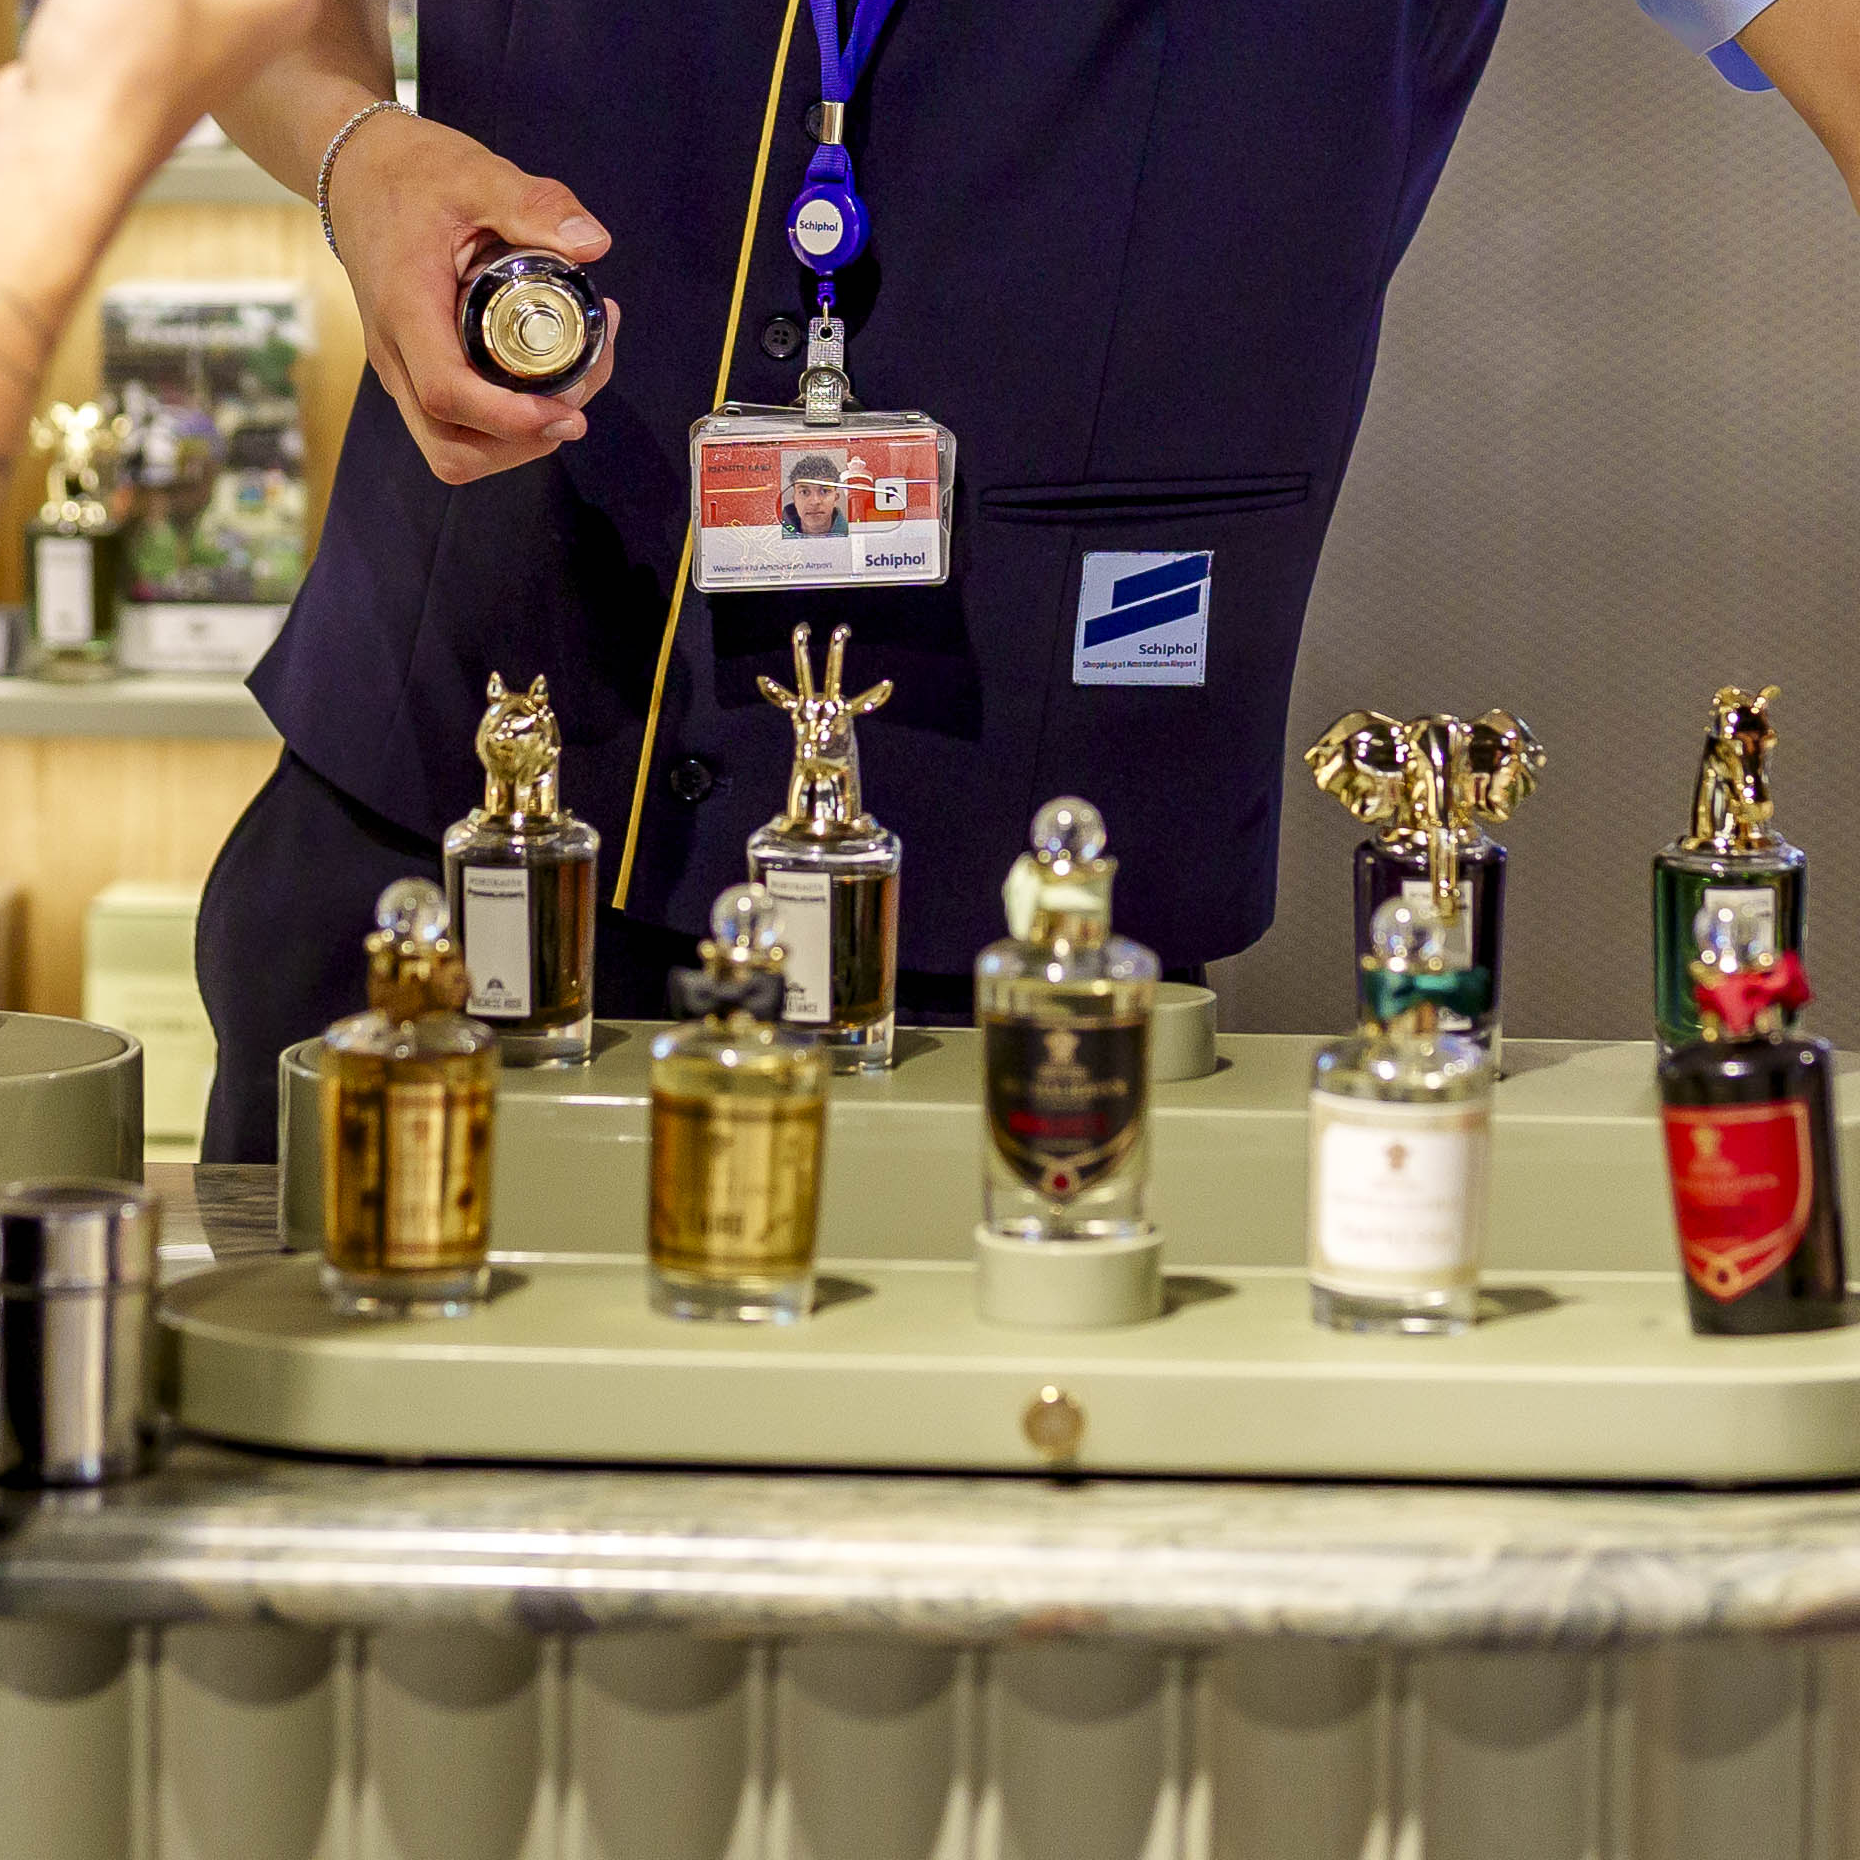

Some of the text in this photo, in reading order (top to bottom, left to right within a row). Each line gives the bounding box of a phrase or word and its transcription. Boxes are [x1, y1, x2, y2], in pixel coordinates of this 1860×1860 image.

[799, 220, 839, 232] Schiphol
[885, 486, 898, 504] P
[865, 552, 925, 571] Schiphol
[1139, 642, 1197, 657] Schiphol
